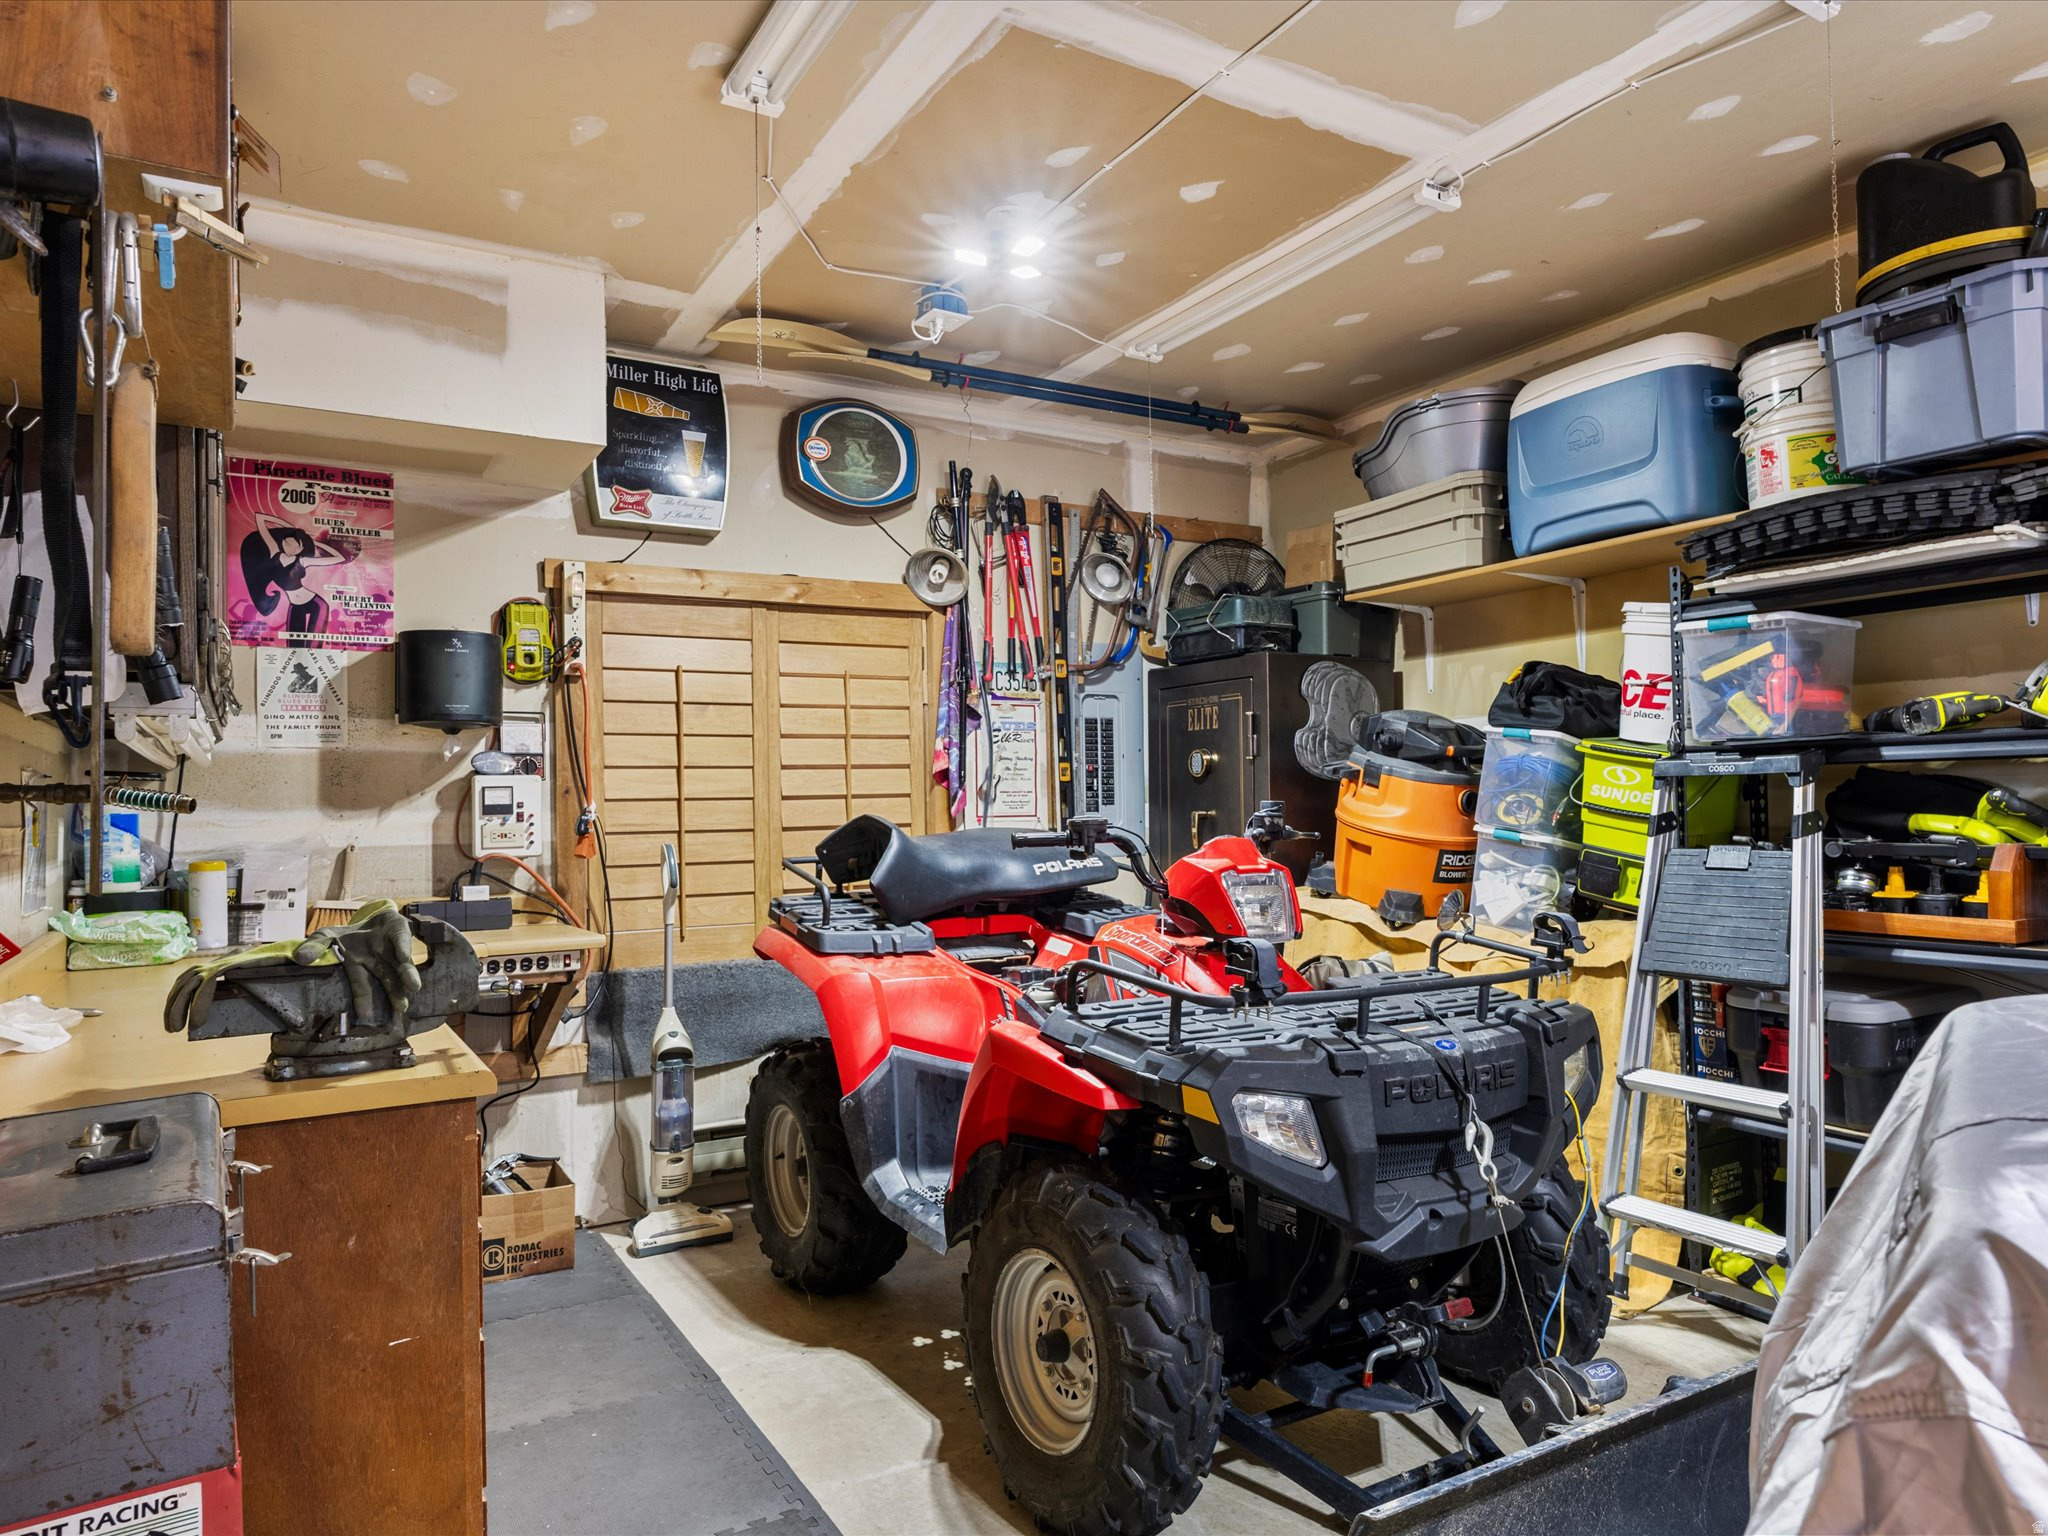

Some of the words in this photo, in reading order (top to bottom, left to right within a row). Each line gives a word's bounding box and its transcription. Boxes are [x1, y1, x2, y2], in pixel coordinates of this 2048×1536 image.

[606, 363, 649, 383] Miller
[654, 370, 687, 392] High
[693, 376, 719, 394] Life
[254, 462, 336, 483] Pinedale
[340, 470, 391, 488] Blues
[281, 488, 316, 505] 2006
[304, 481, 391, 497] Festival
[619, 492, 645, 503] Miller
[314, 517, 346, 527] BLUES
[331, 527, 381, 537] TRAVELER
[332, 594, 372, 603] DELBERT
[307, 647, 319, 665] CARL
[260, 676, 282, 708] BLINDDOG
[1188, 706, 1219, 731] ELITE
[1633, 710, 1664, 720] place.
[1708, 764, 1736, 773] COSCO
[1589, 783, 1653, 805] SUNJOE
[1032, 857, 1104, 876] POLARIS
[1439, 870, 1467, 879] BLOWER
[1694, 1026, 1726, 1038] IOCCHI
[1697, 1064, 1735, 1078] FIOCCHI
[507, 1241, 542, 1254] ROMAC
[507, 1247, 565, 1265] INDUSTRIES
[507, 1263, 524, 1275] INC
[78, 1494, 180, 1536] RACING
